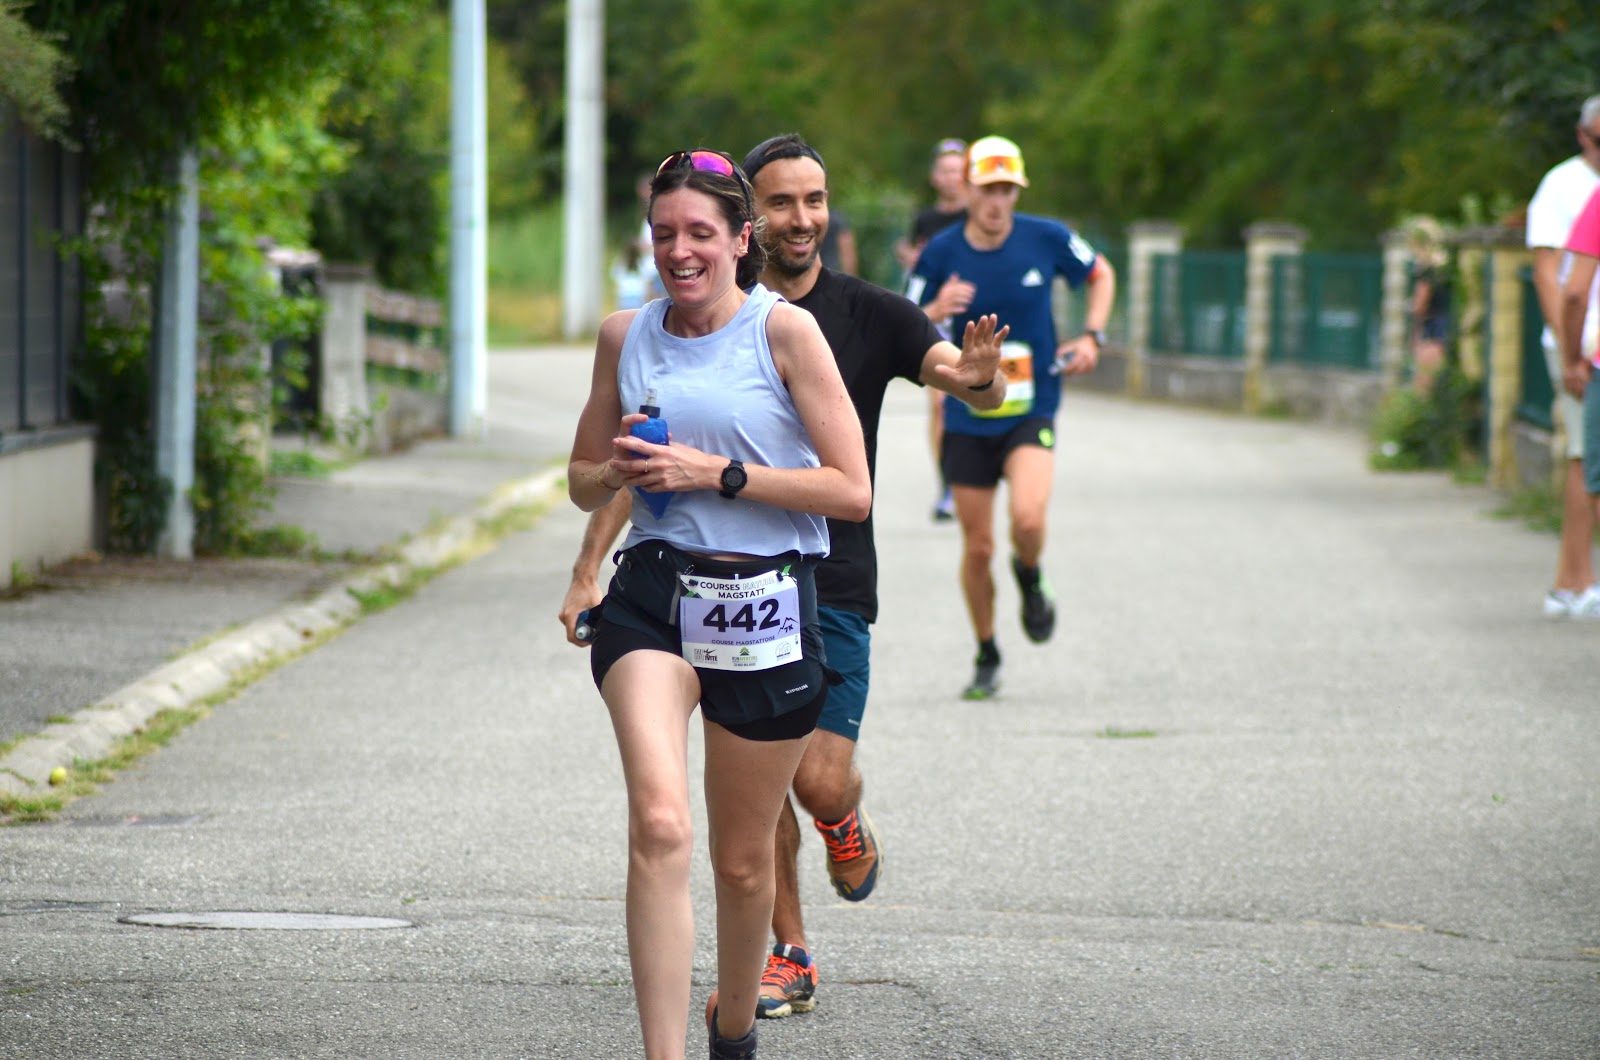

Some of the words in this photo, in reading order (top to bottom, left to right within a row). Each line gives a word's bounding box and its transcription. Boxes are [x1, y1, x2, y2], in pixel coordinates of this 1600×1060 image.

[700, 581, 740, 591] COURSES
[718, 588, 766, 599] MAGSTATT
[703, 598, 780, 632] 442
